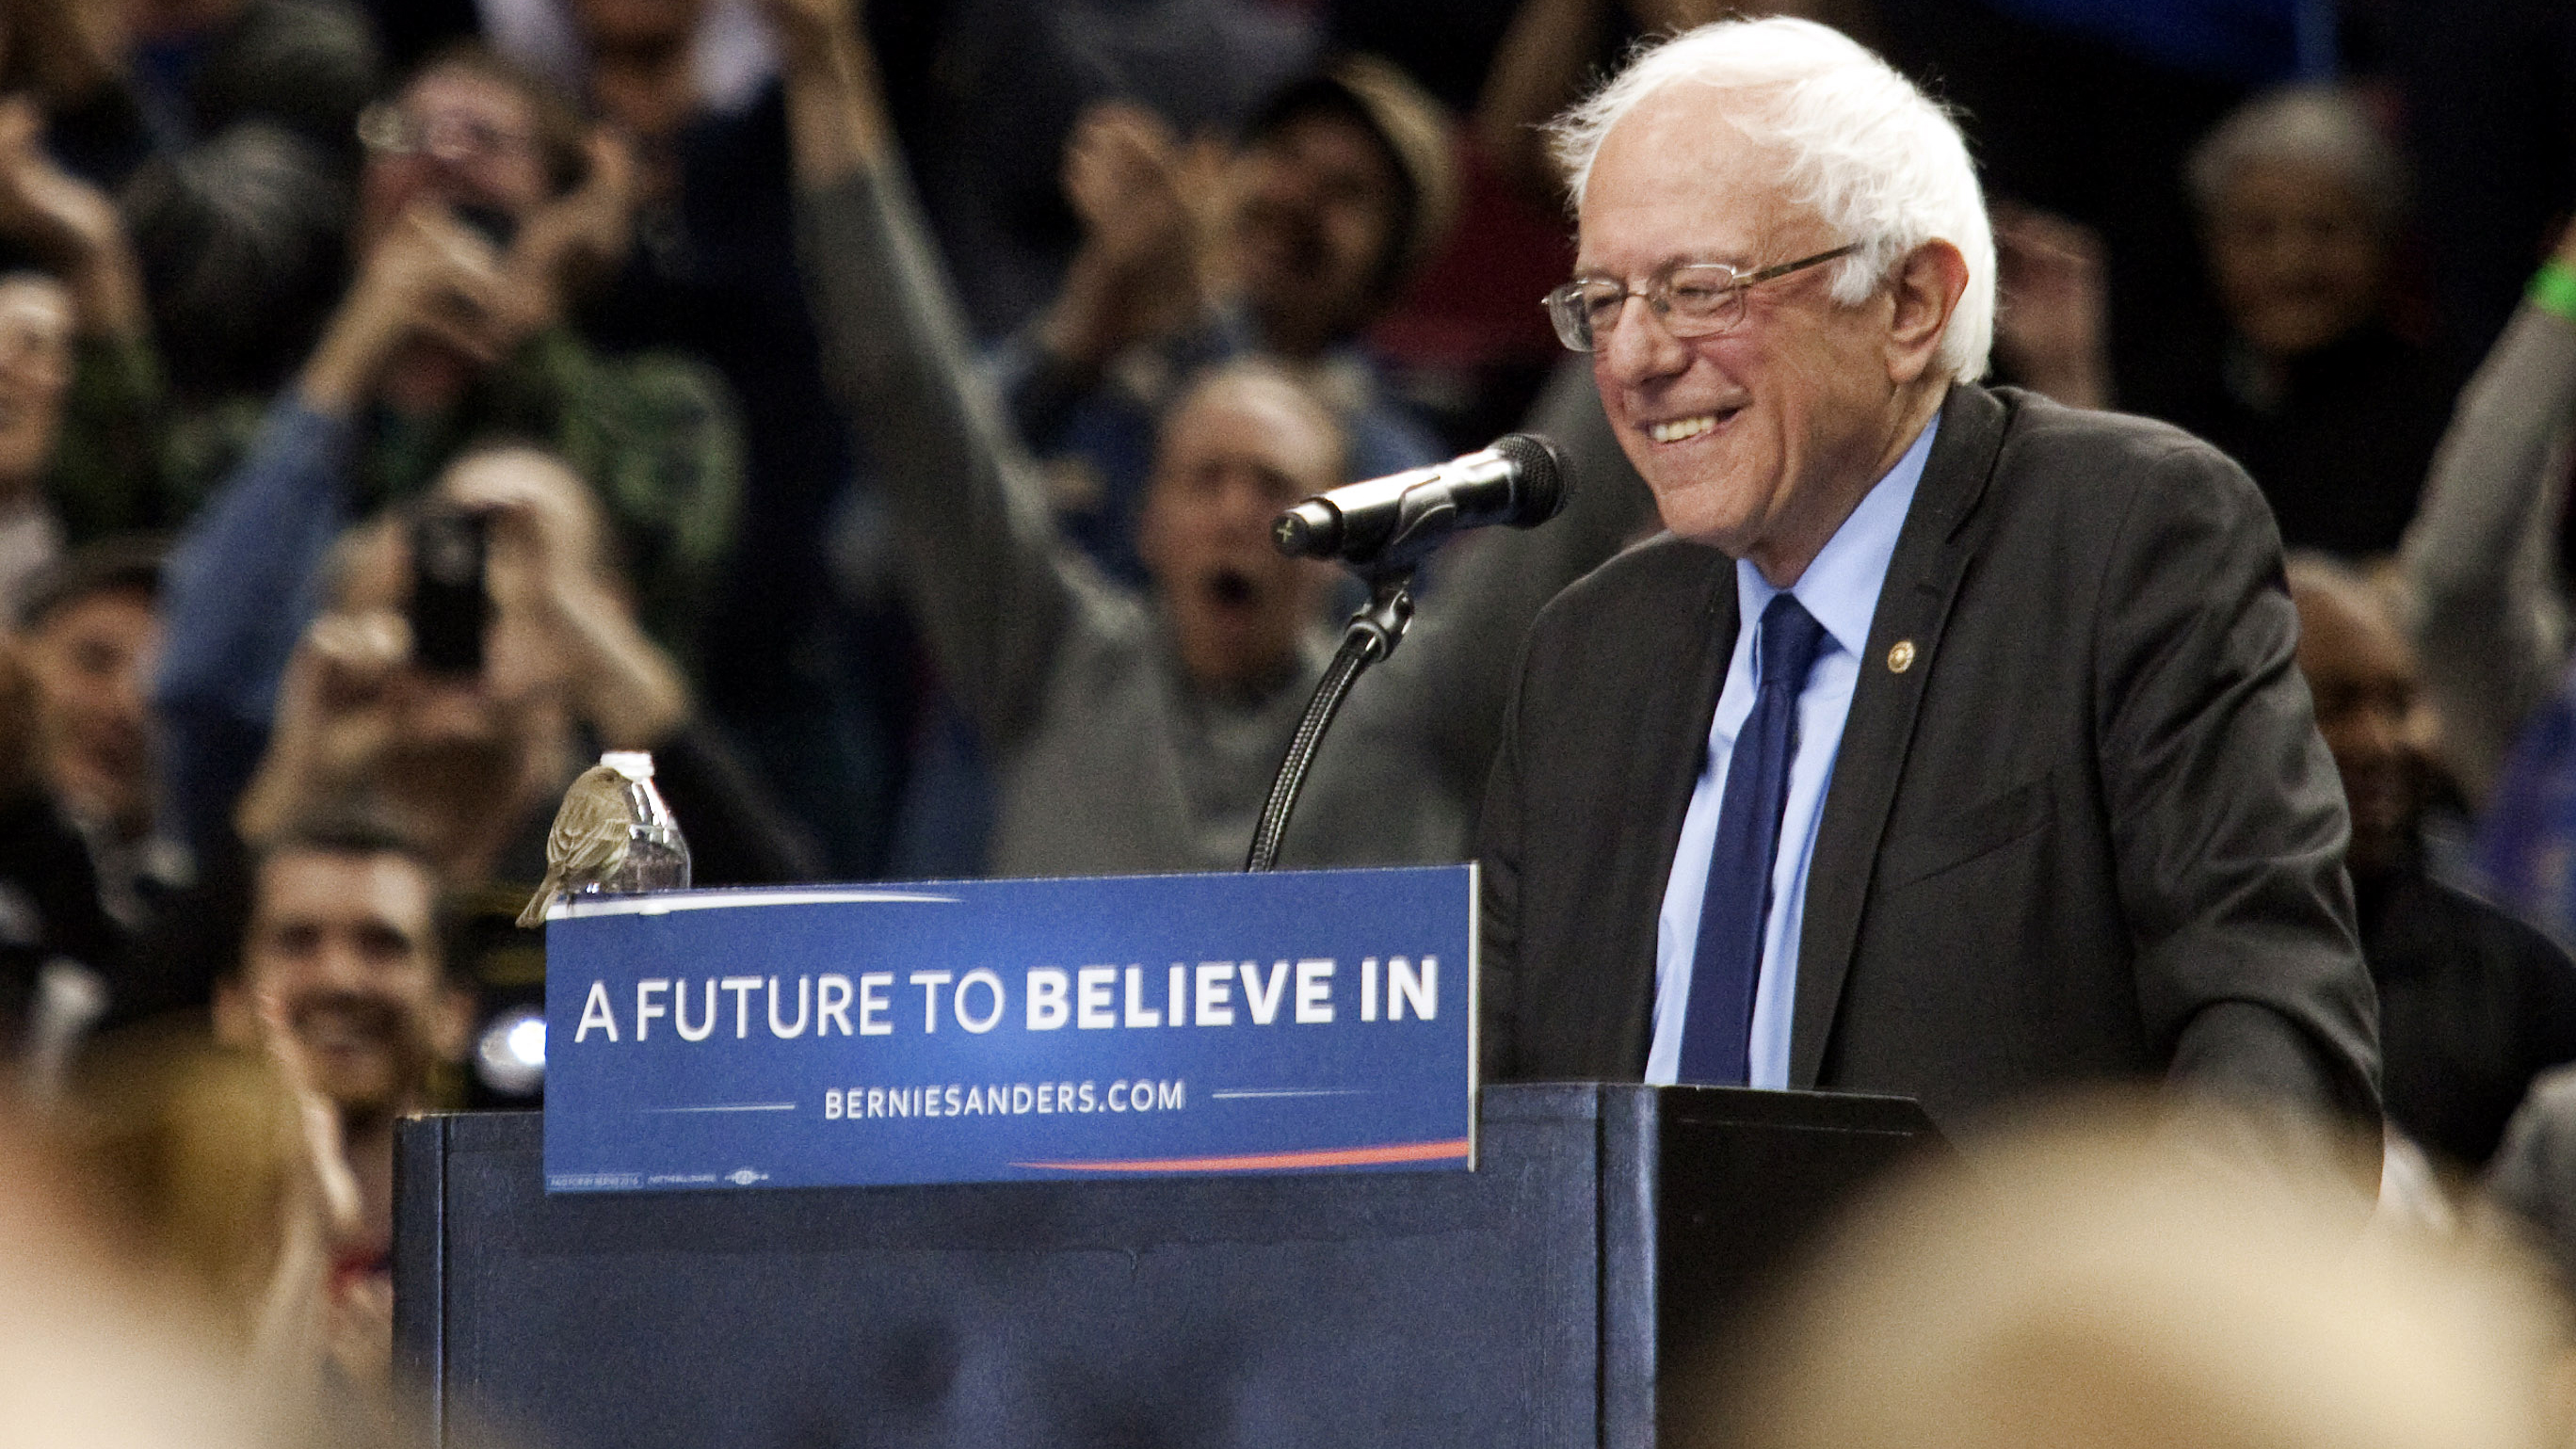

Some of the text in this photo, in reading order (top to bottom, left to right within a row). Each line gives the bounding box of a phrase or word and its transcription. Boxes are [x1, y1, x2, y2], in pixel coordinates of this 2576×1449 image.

[574, 956, 1439, 1043] A FUTURE TO BELIEVE IN
[825, 1079, 1185, 1120] BERNIESANDERS.COM
